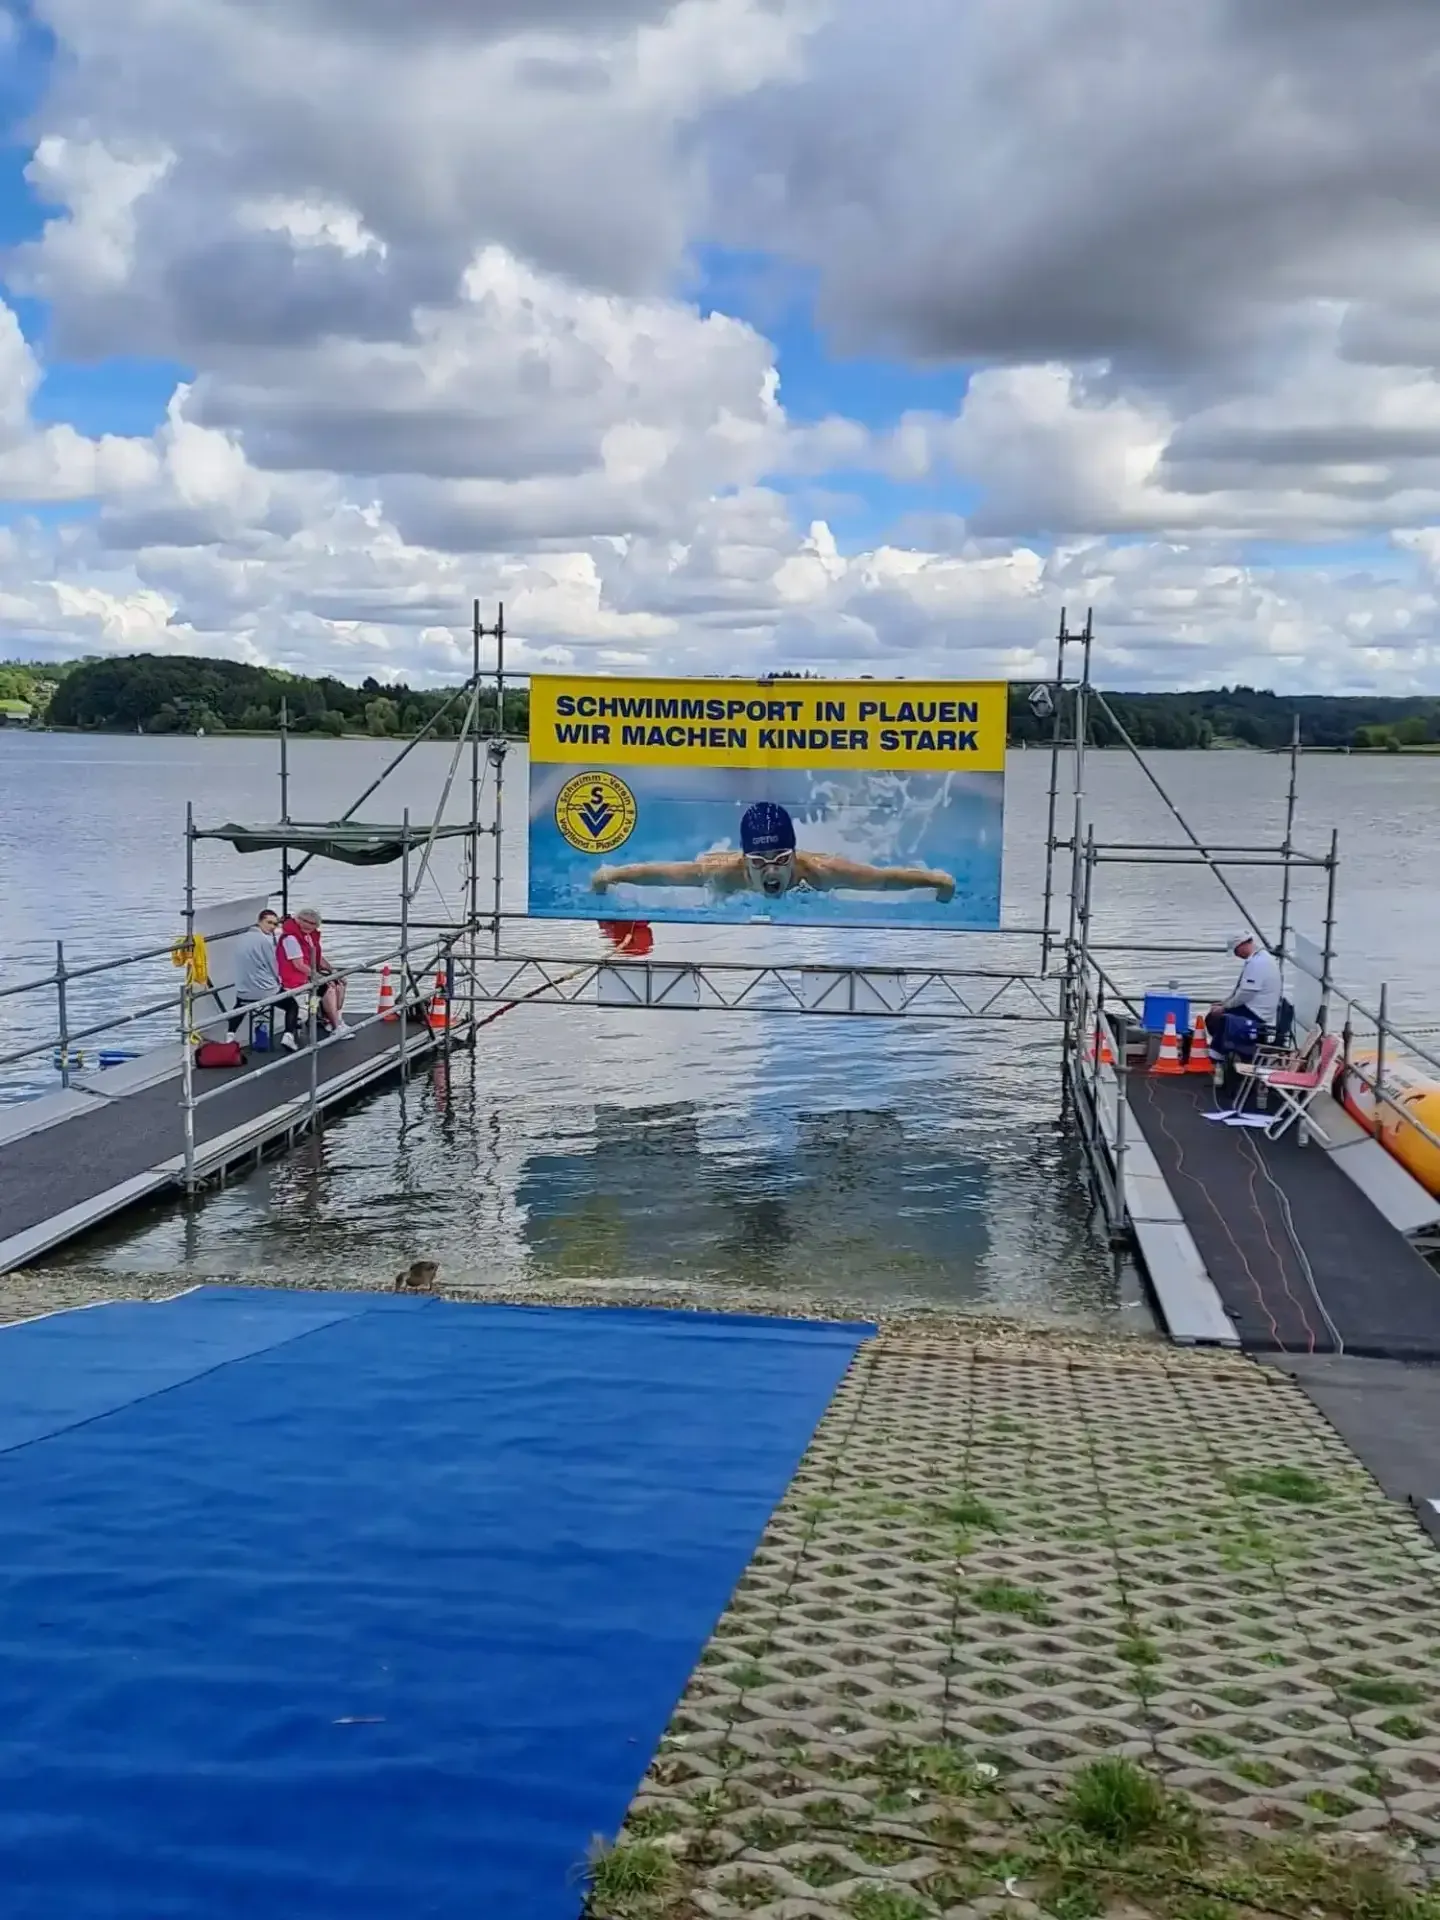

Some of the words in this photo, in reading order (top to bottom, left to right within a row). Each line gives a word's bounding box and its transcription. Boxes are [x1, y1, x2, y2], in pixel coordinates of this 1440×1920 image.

[556, 695, 803, 722] SCHWIMMSPORT
[816, 701, 845, 722] IN
[859, 701, 978, 723] PLAUEN
[555, 723, 610, 745] WIR
[622, 726, 747, 748] MACHEN
[758, 728, 869, 750] KINDER
[880, 729, 979, 751] STARK
[560, 775, 601, 803] Schwimm
[610, 778, 631, 806] Verein
